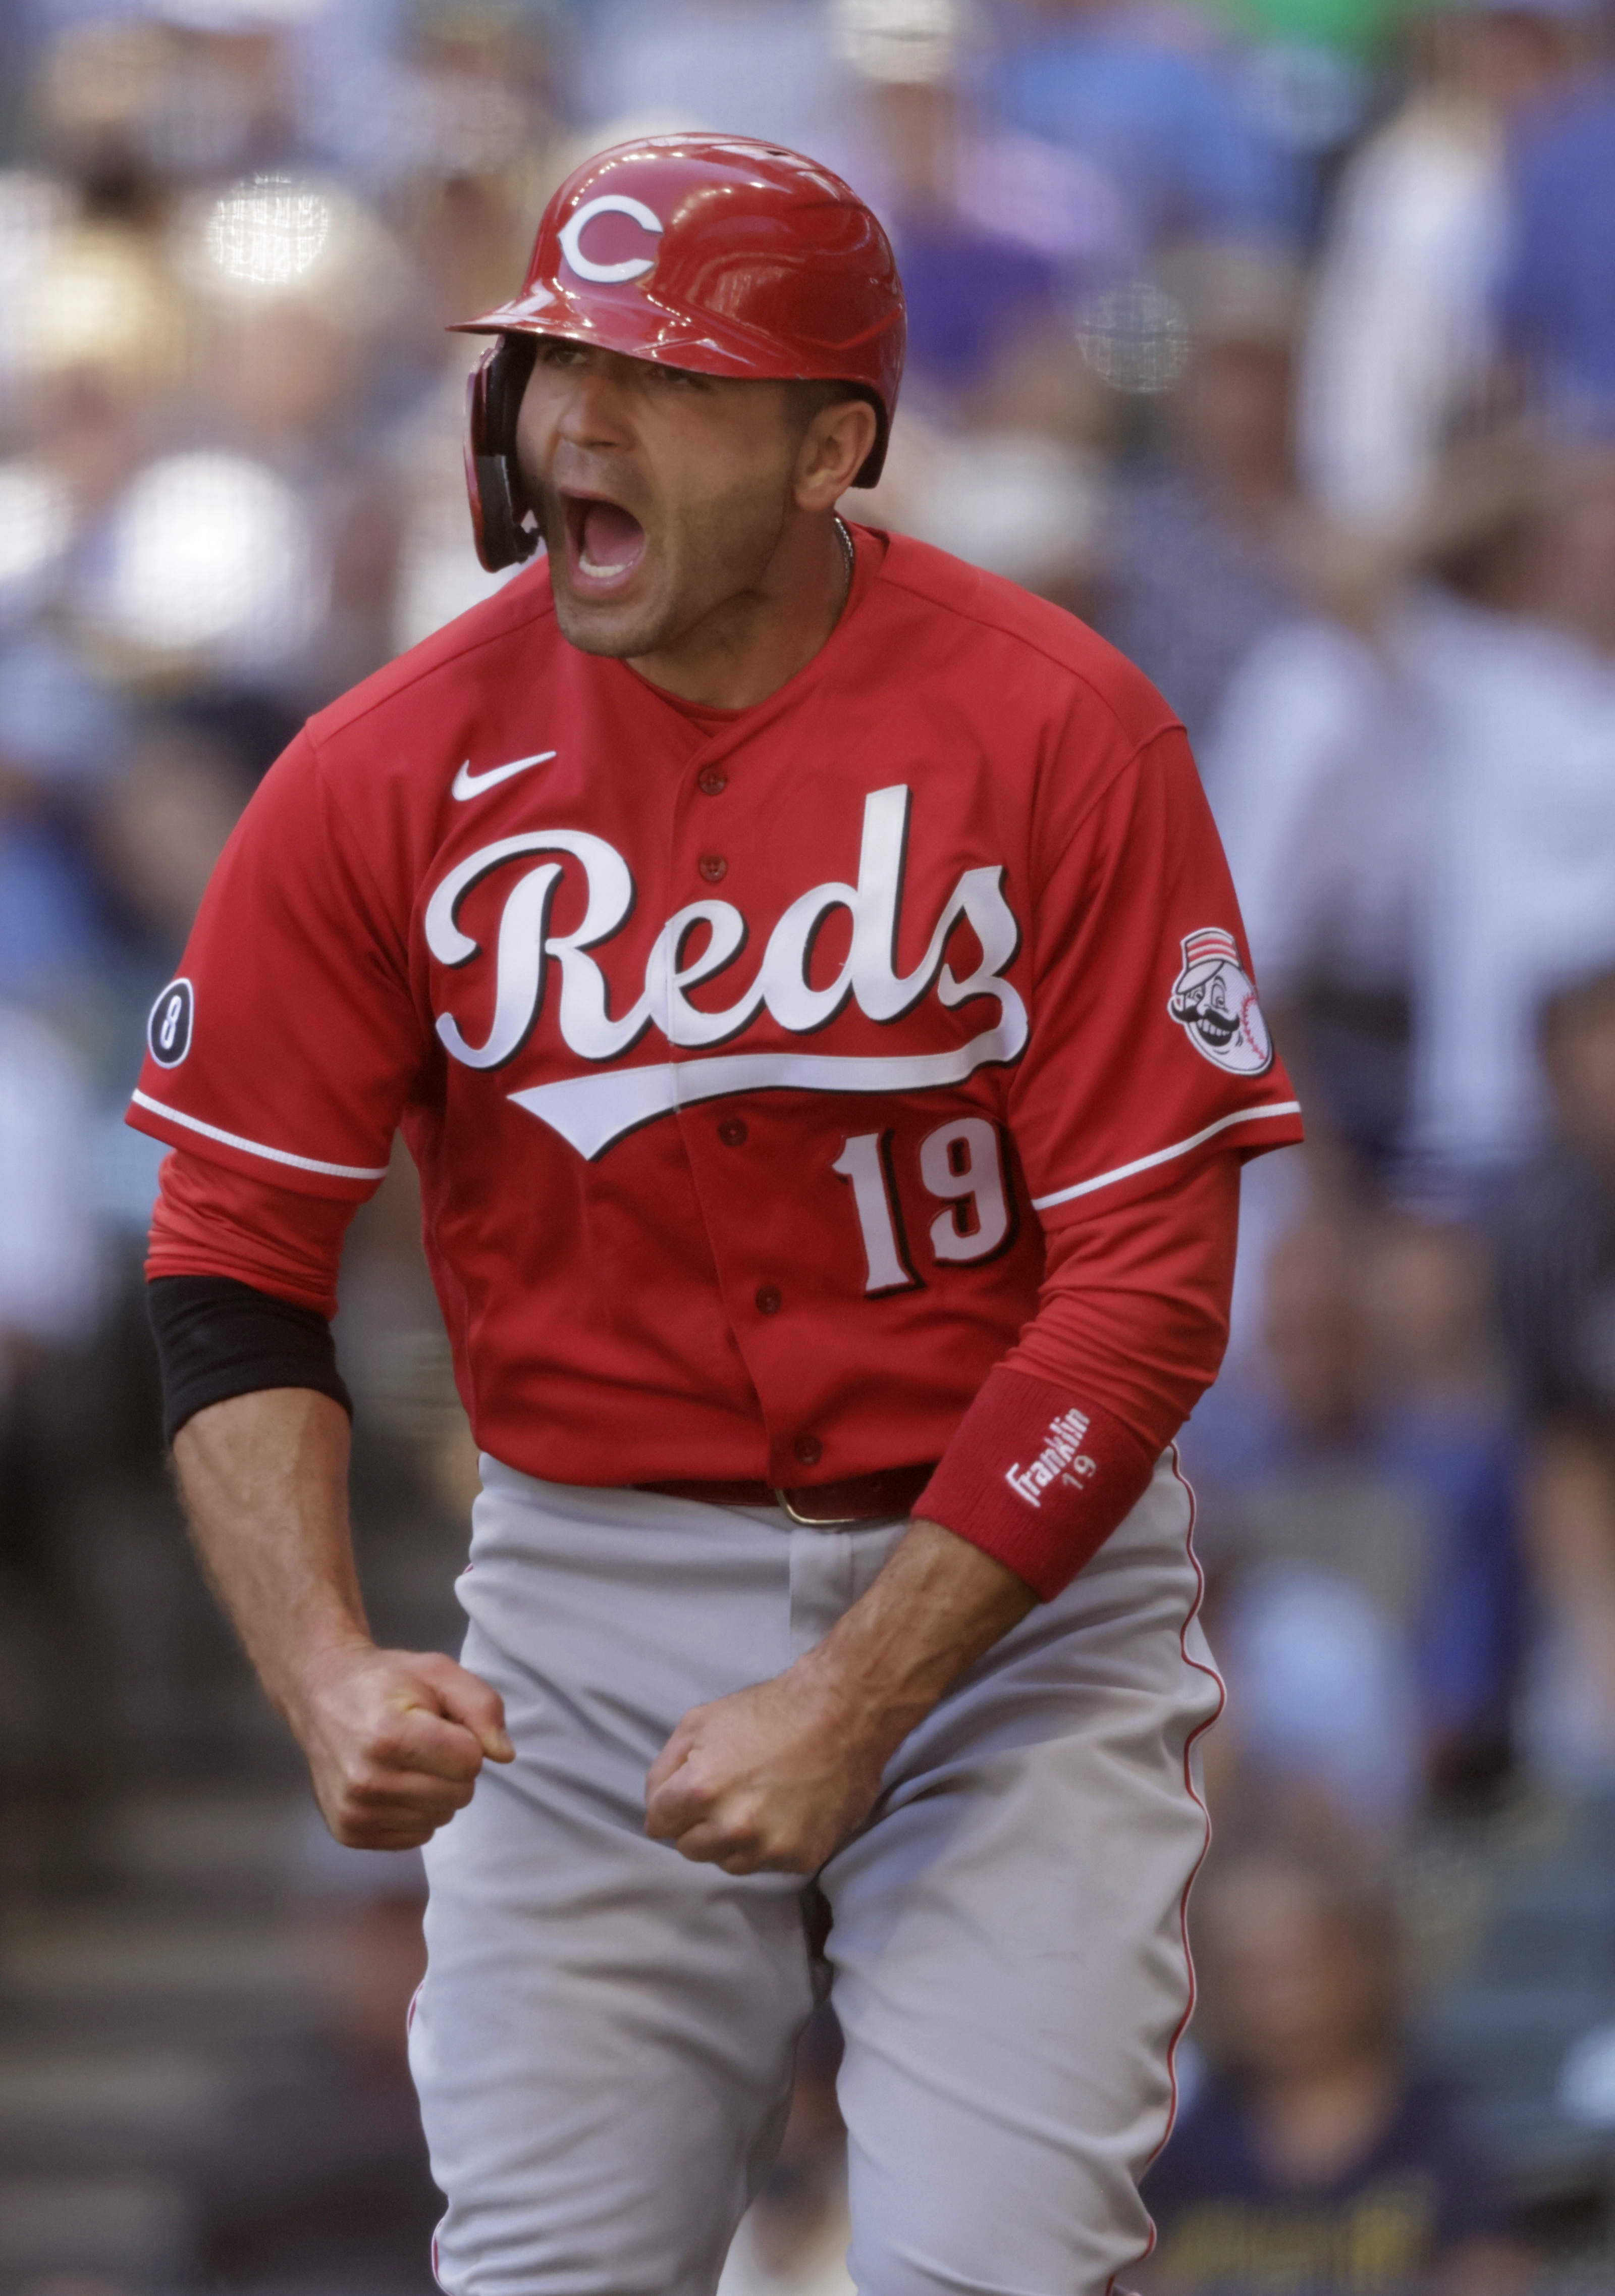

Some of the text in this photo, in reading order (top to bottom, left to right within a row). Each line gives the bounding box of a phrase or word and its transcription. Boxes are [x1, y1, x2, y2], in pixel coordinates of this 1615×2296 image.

[558, 194, 663, 284] C
[424, 784, 1030, 1072] Reds
[160, 995, 182, 1050] 8
[832, 1118, 1019, 1299] 19
[1005, 1407, 1090, 1508] Franklin
[1062, 1454, 1097, 1490] 19
